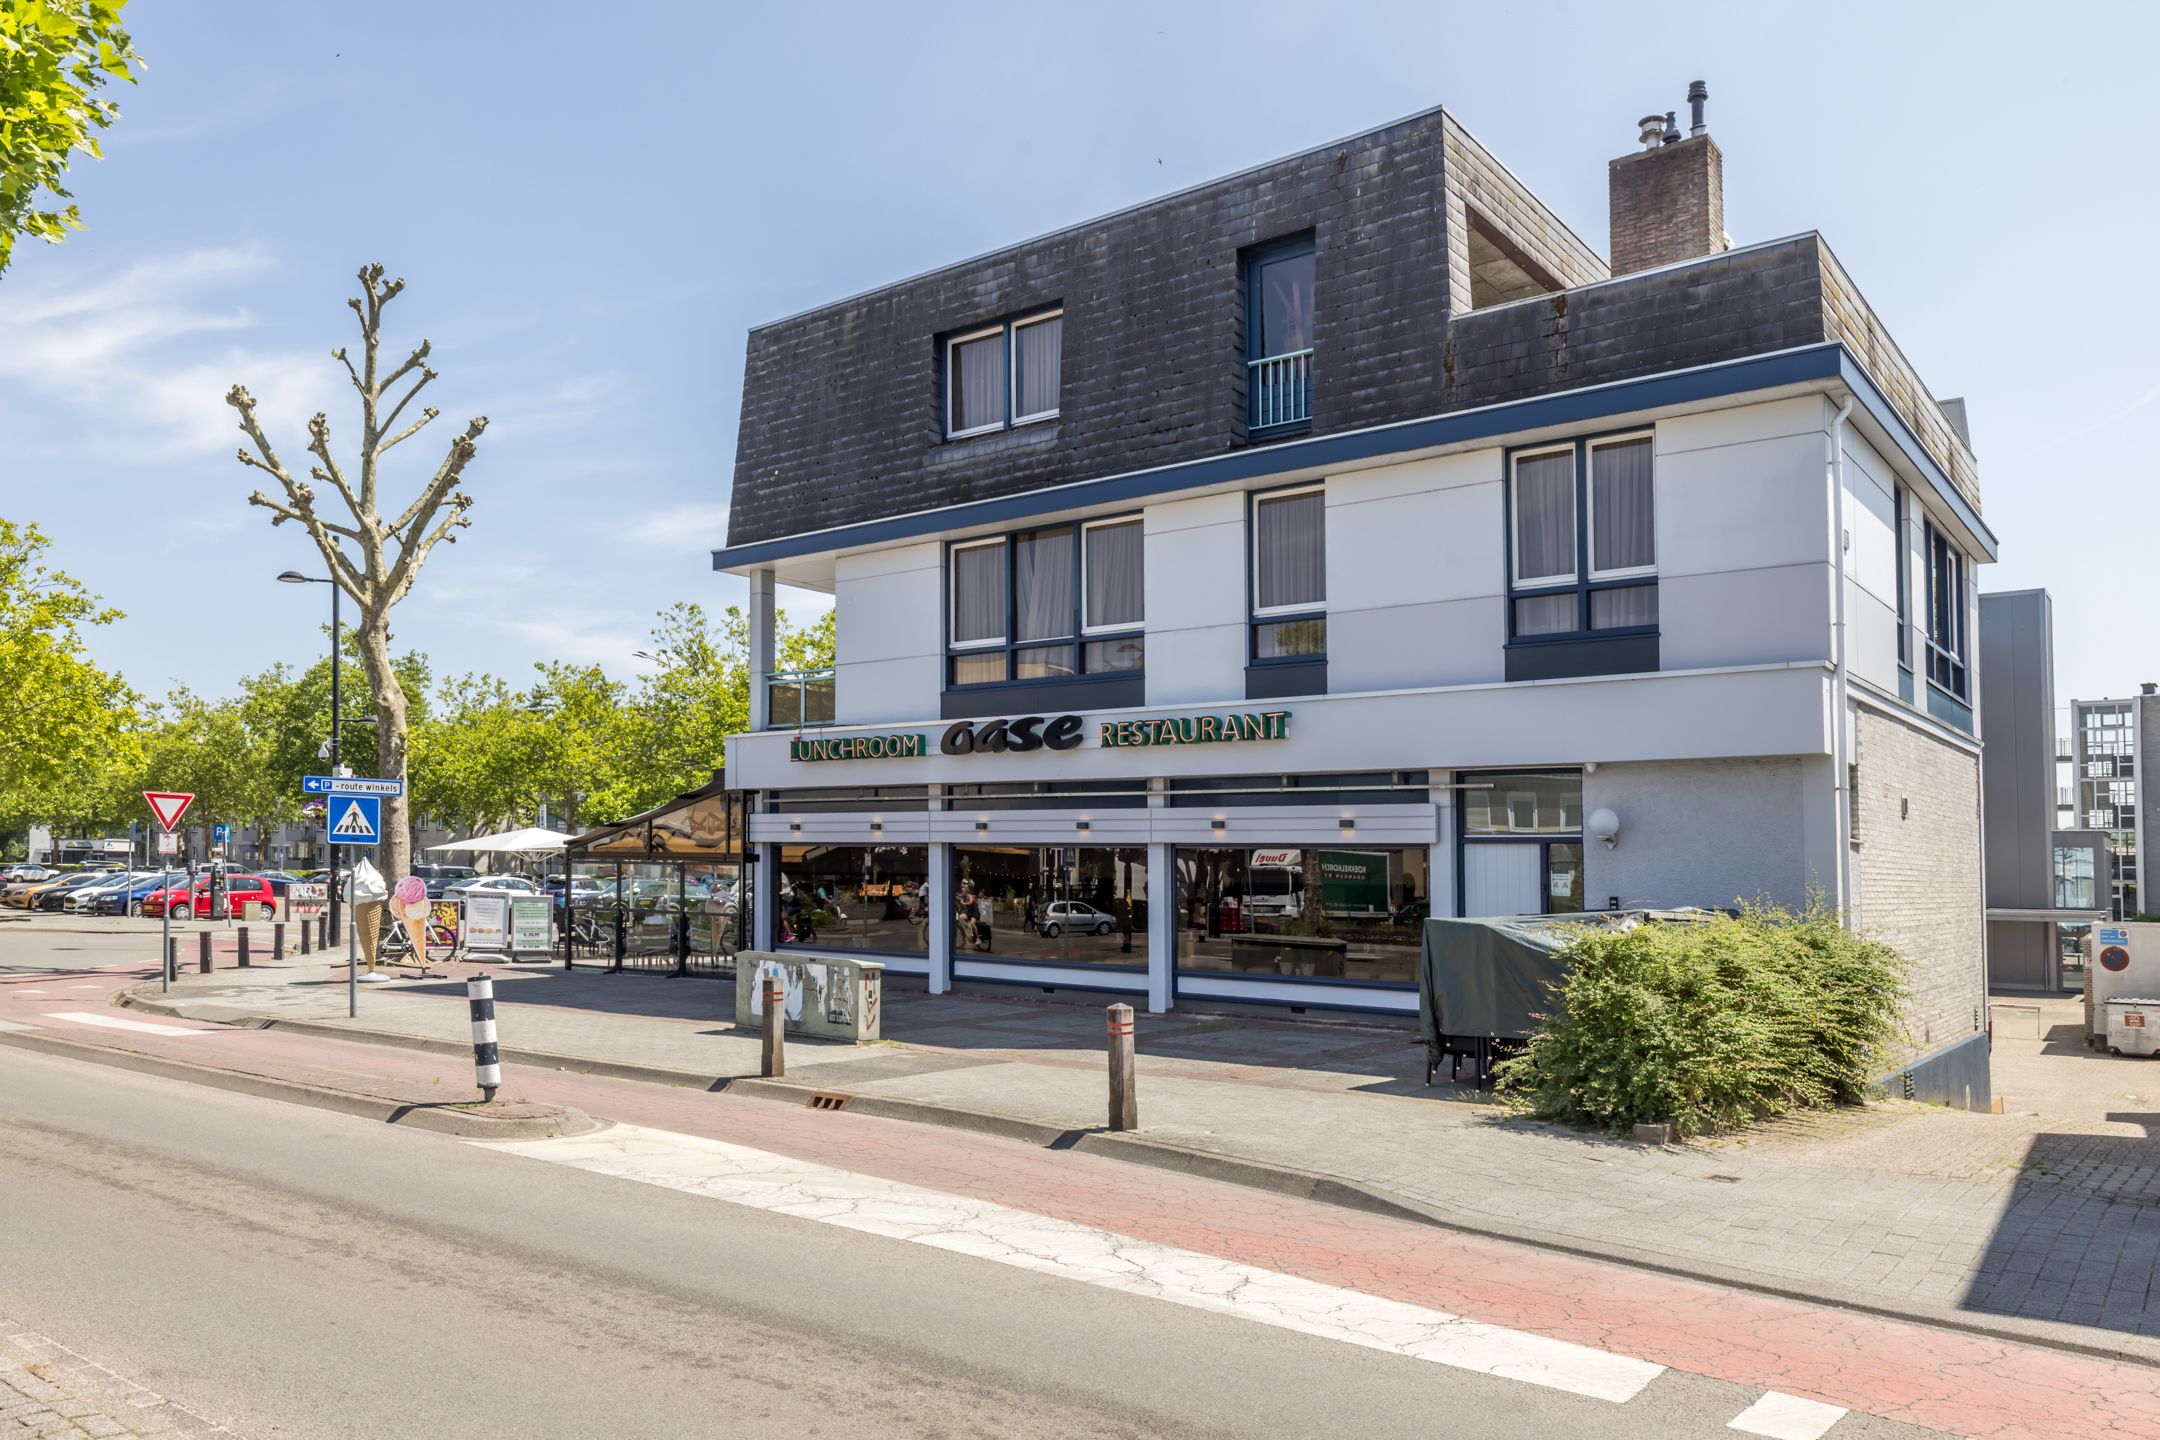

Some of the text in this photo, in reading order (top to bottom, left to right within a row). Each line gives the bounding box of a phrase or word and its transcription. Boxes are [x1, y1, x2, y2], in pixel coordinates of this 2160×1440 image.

[940, 714, 1084, 755] oase
[1100, 711, 1292, 747] RESTAURANT
[790, 734, 926, 762] LUNCHROOM
[365, 783, 398, 793] winkels
